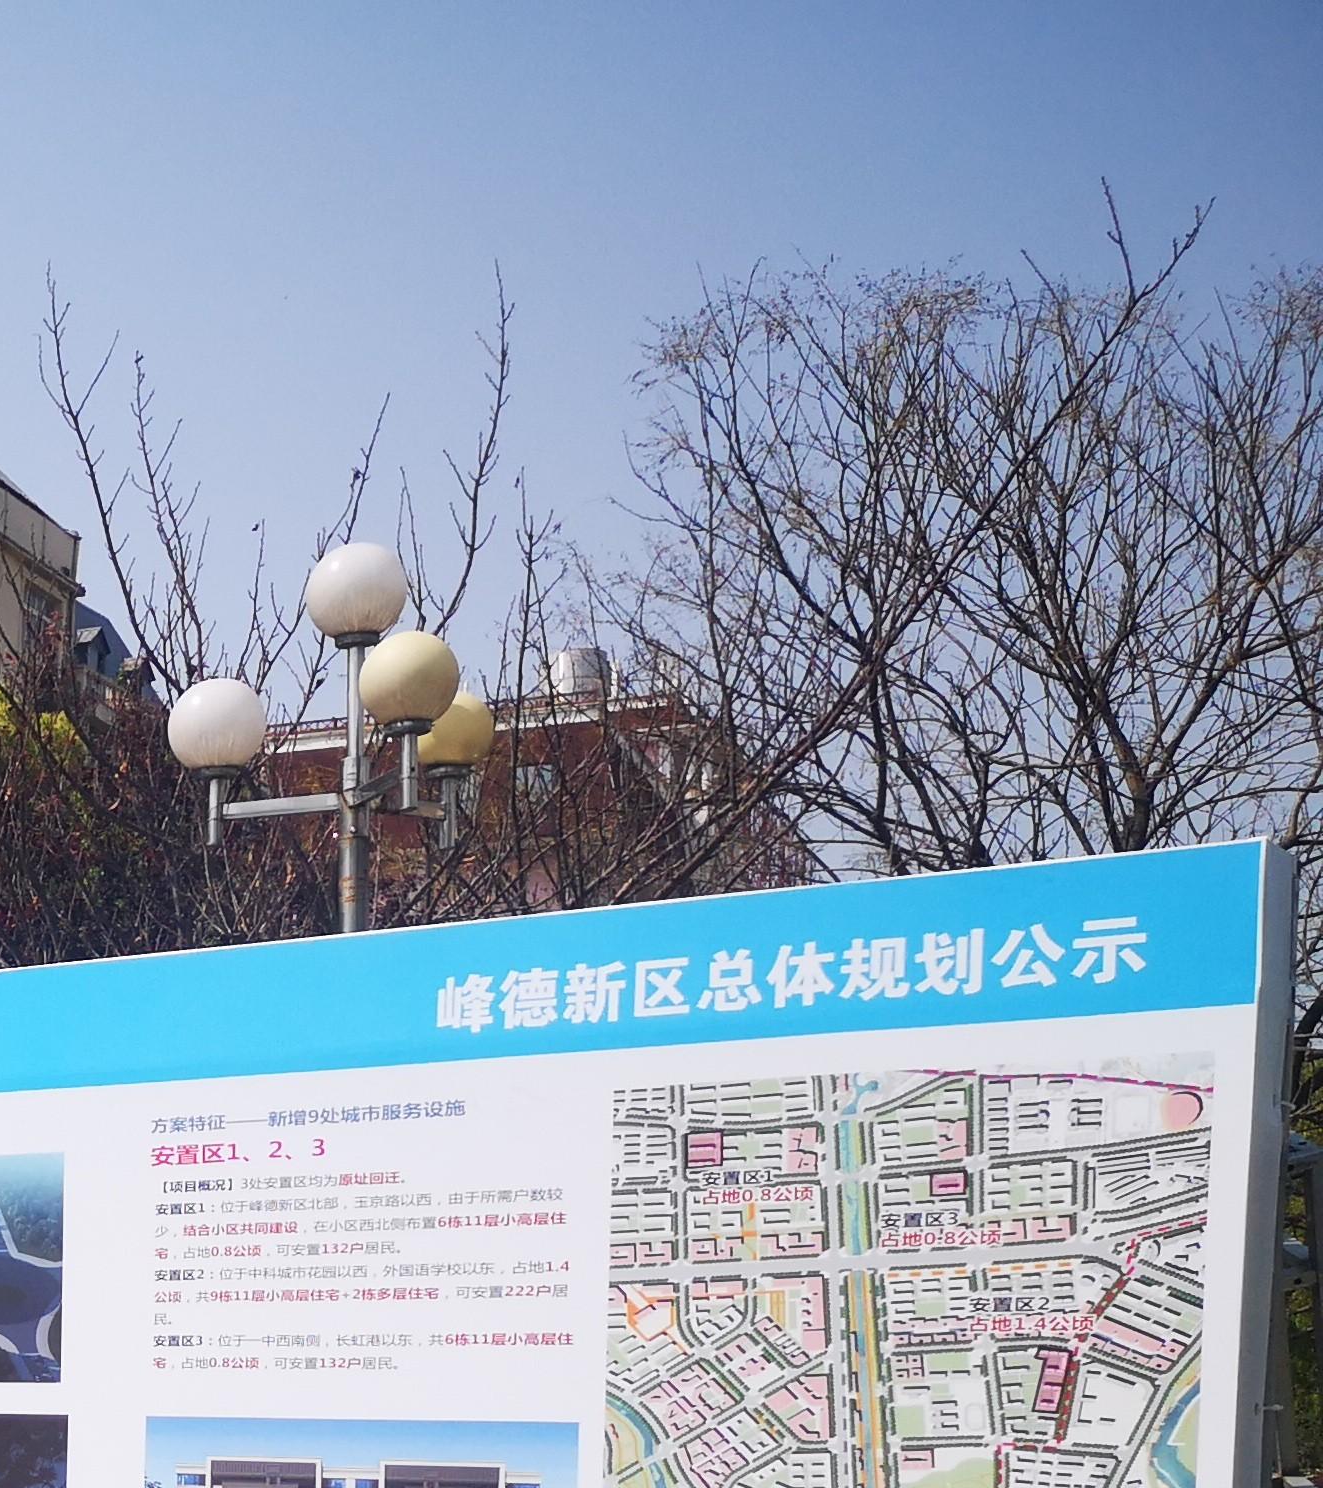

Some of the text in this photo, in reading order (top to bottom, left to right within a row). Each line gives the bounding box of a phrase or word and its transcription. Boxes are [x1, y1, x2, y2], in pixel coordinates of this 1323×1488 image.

[434, 915, 1148, 1036] 峰德新区总体规划公示
[151, 1099, 467, 1134] 方案特征——新增9处城市服务设施
[151, 1138, 327, 1167] 安置区1、2、3
[701, 1168, 776, 1187] 安置区1
[701, 1186, 815, 1206] 占地0.8公顷
[881, 1211, 961, 1230] 安置区3
[970, 1295, 1051, 1314] 安置区2
[969, 1314, 1095, 1333] 占地1.4公顷
